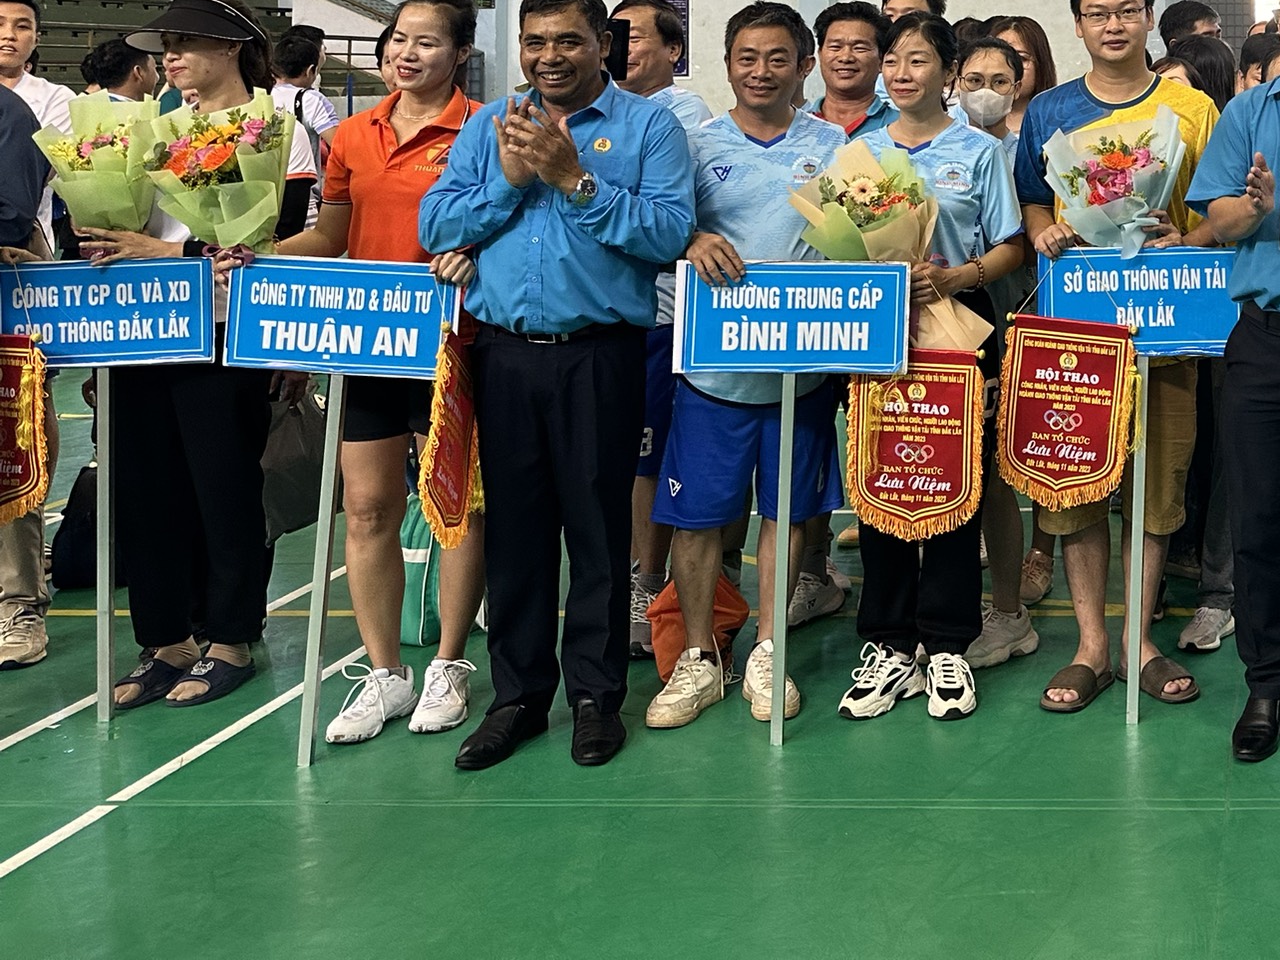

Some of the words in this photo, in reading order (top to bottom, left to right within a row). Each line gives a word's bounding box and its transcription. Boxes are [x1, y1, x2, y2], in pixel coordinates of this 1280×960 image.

[1064, 265, 1082, 293] SỞ
[1087, 270, 1119, 292] GIAO
[1122, 265, 1168, 292] THÔNG
[1173, 264, 1200, 294] VẬN
[1204, 261, 1226, 289] TẢI
[12, 283, 58, 309] CÔNG
[63, 286, 83, 307] TY
[88, 283, 110, 306] CP
[116, 282, 136, 307] QL
[141, 278, 164, 303] VÀ
[168, 281, 190, 302] XD
[251, 278, 286, 306] CÔNG
[290, 284, 306, 307] TY
[309, 285, 343, 310] TNHH
[346, 287, 365, 311] XD
[368, 292, 379, 311] &
[383, 282, 411, 313] ĐẦU
[415, 290, 433, 314] TƯ
[711, 282, 780, 310] TRƯỜNG
[786, 287, 843, 310] TRUNG
[848, 280, 883, 310] CẤP
[58, 317, 113, 343] THÔNG
[119, 311, 154, 340] ĐẮK
[158, 309, 190, 338] LẮK
[1116, 298, 1144, 327] ĐẮK
[1149, 298, 1175, 327] LẮK
[260, 318, 363, 359] THUẬN
[371, 326, 418, 357] AN
[721, 316, 788, 351] BÌNH
[796, 321, 869, 351] MINH
[1035, 368, 1060, 382] HỘI
[1063, 372, 1099, 384] THAO
[912, 404, 949, 415] THAO
[1032, 432, 1050, 440] BAN
[1022, 440, 1051, 456] Lưu
[1055, 443, 1097, 463] Niệm
[874, 473, 904, 489] Lưu
[908, 475, 951, 494] Niệm
